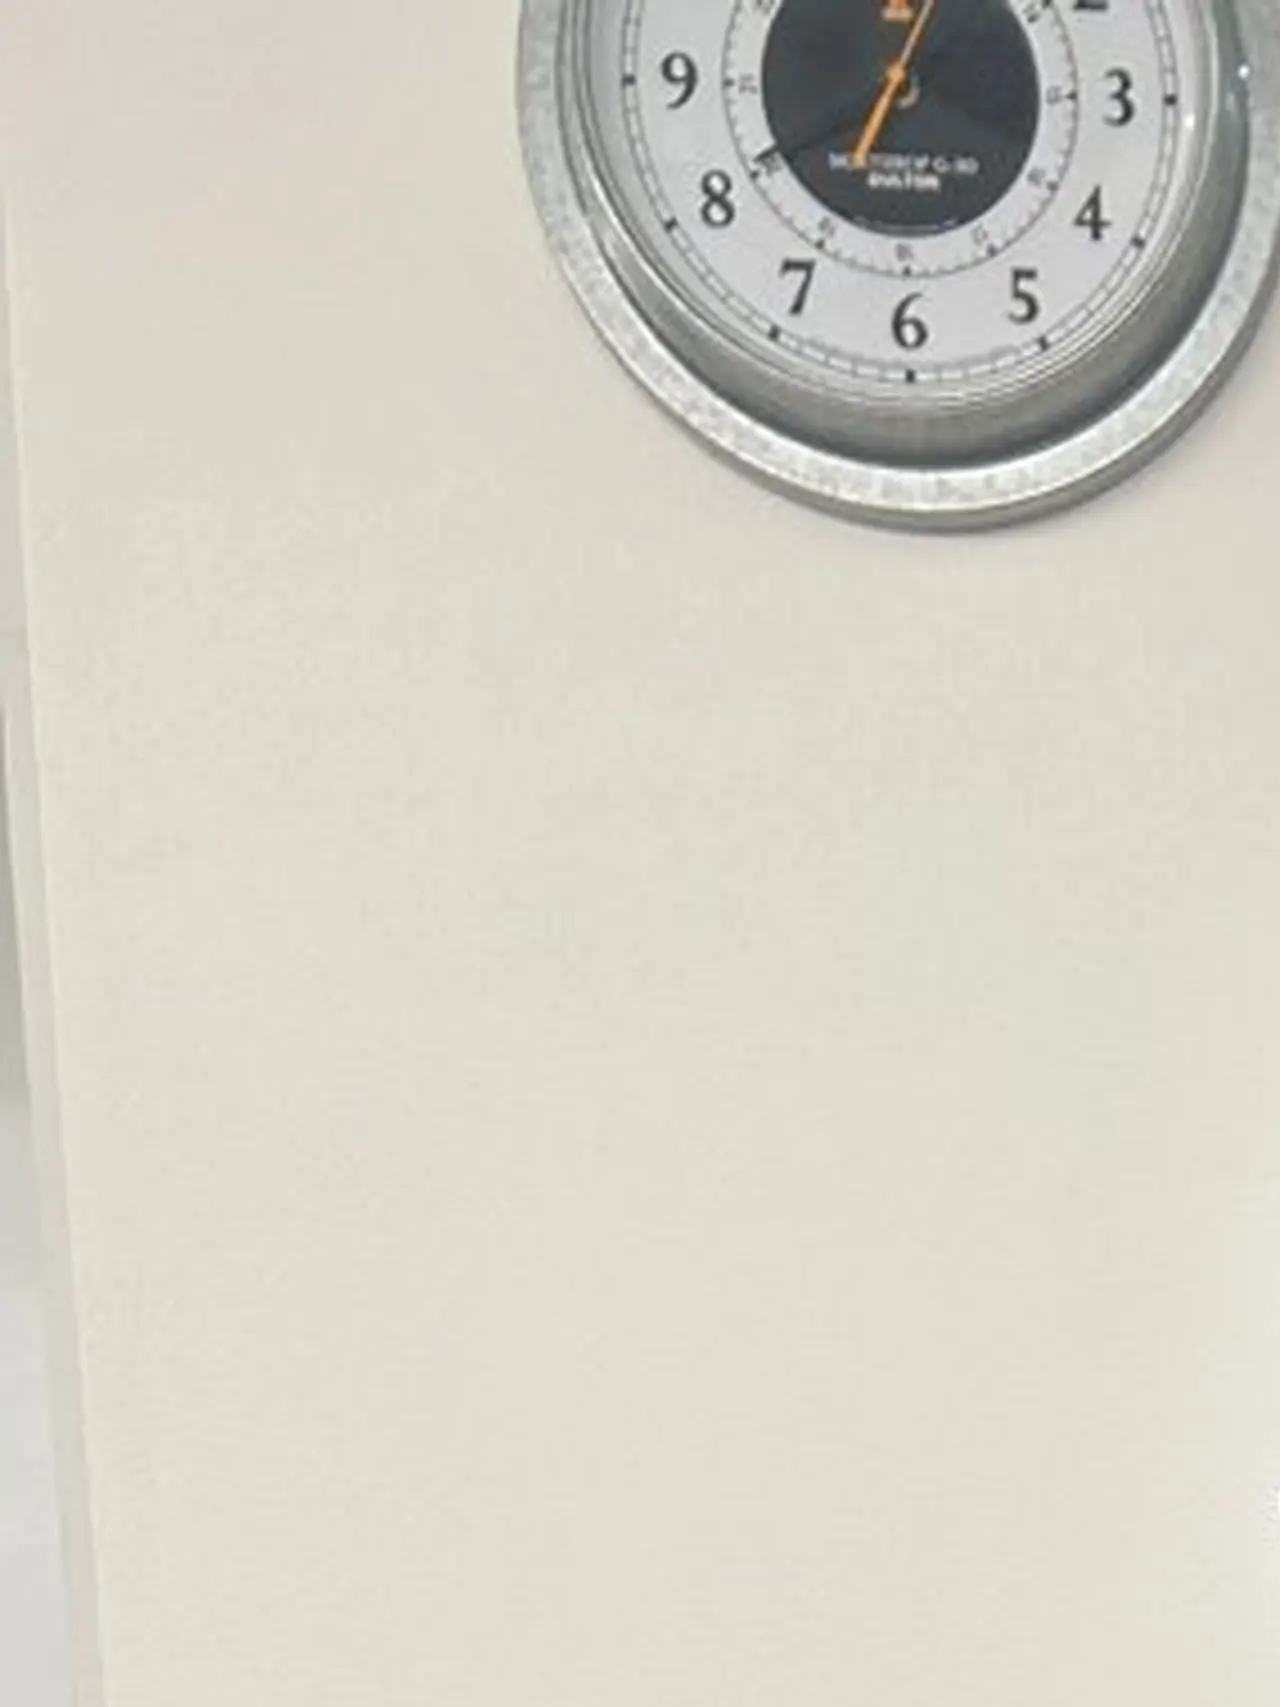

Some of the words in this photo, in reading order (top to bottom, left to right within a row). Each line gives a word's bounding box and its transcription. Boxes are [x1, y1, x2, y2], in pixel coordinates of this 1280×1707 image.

[660, 52, 698, 109] 9
[1104, 66, 1135, 127] 3
[700, 169, 736, 229] 8
[1074, 185, 1112, 242] 4
[780, 258, 816, 316] 7
[1008, 268, 1039, 325] 5
[890, 292, 928, 350] 6
